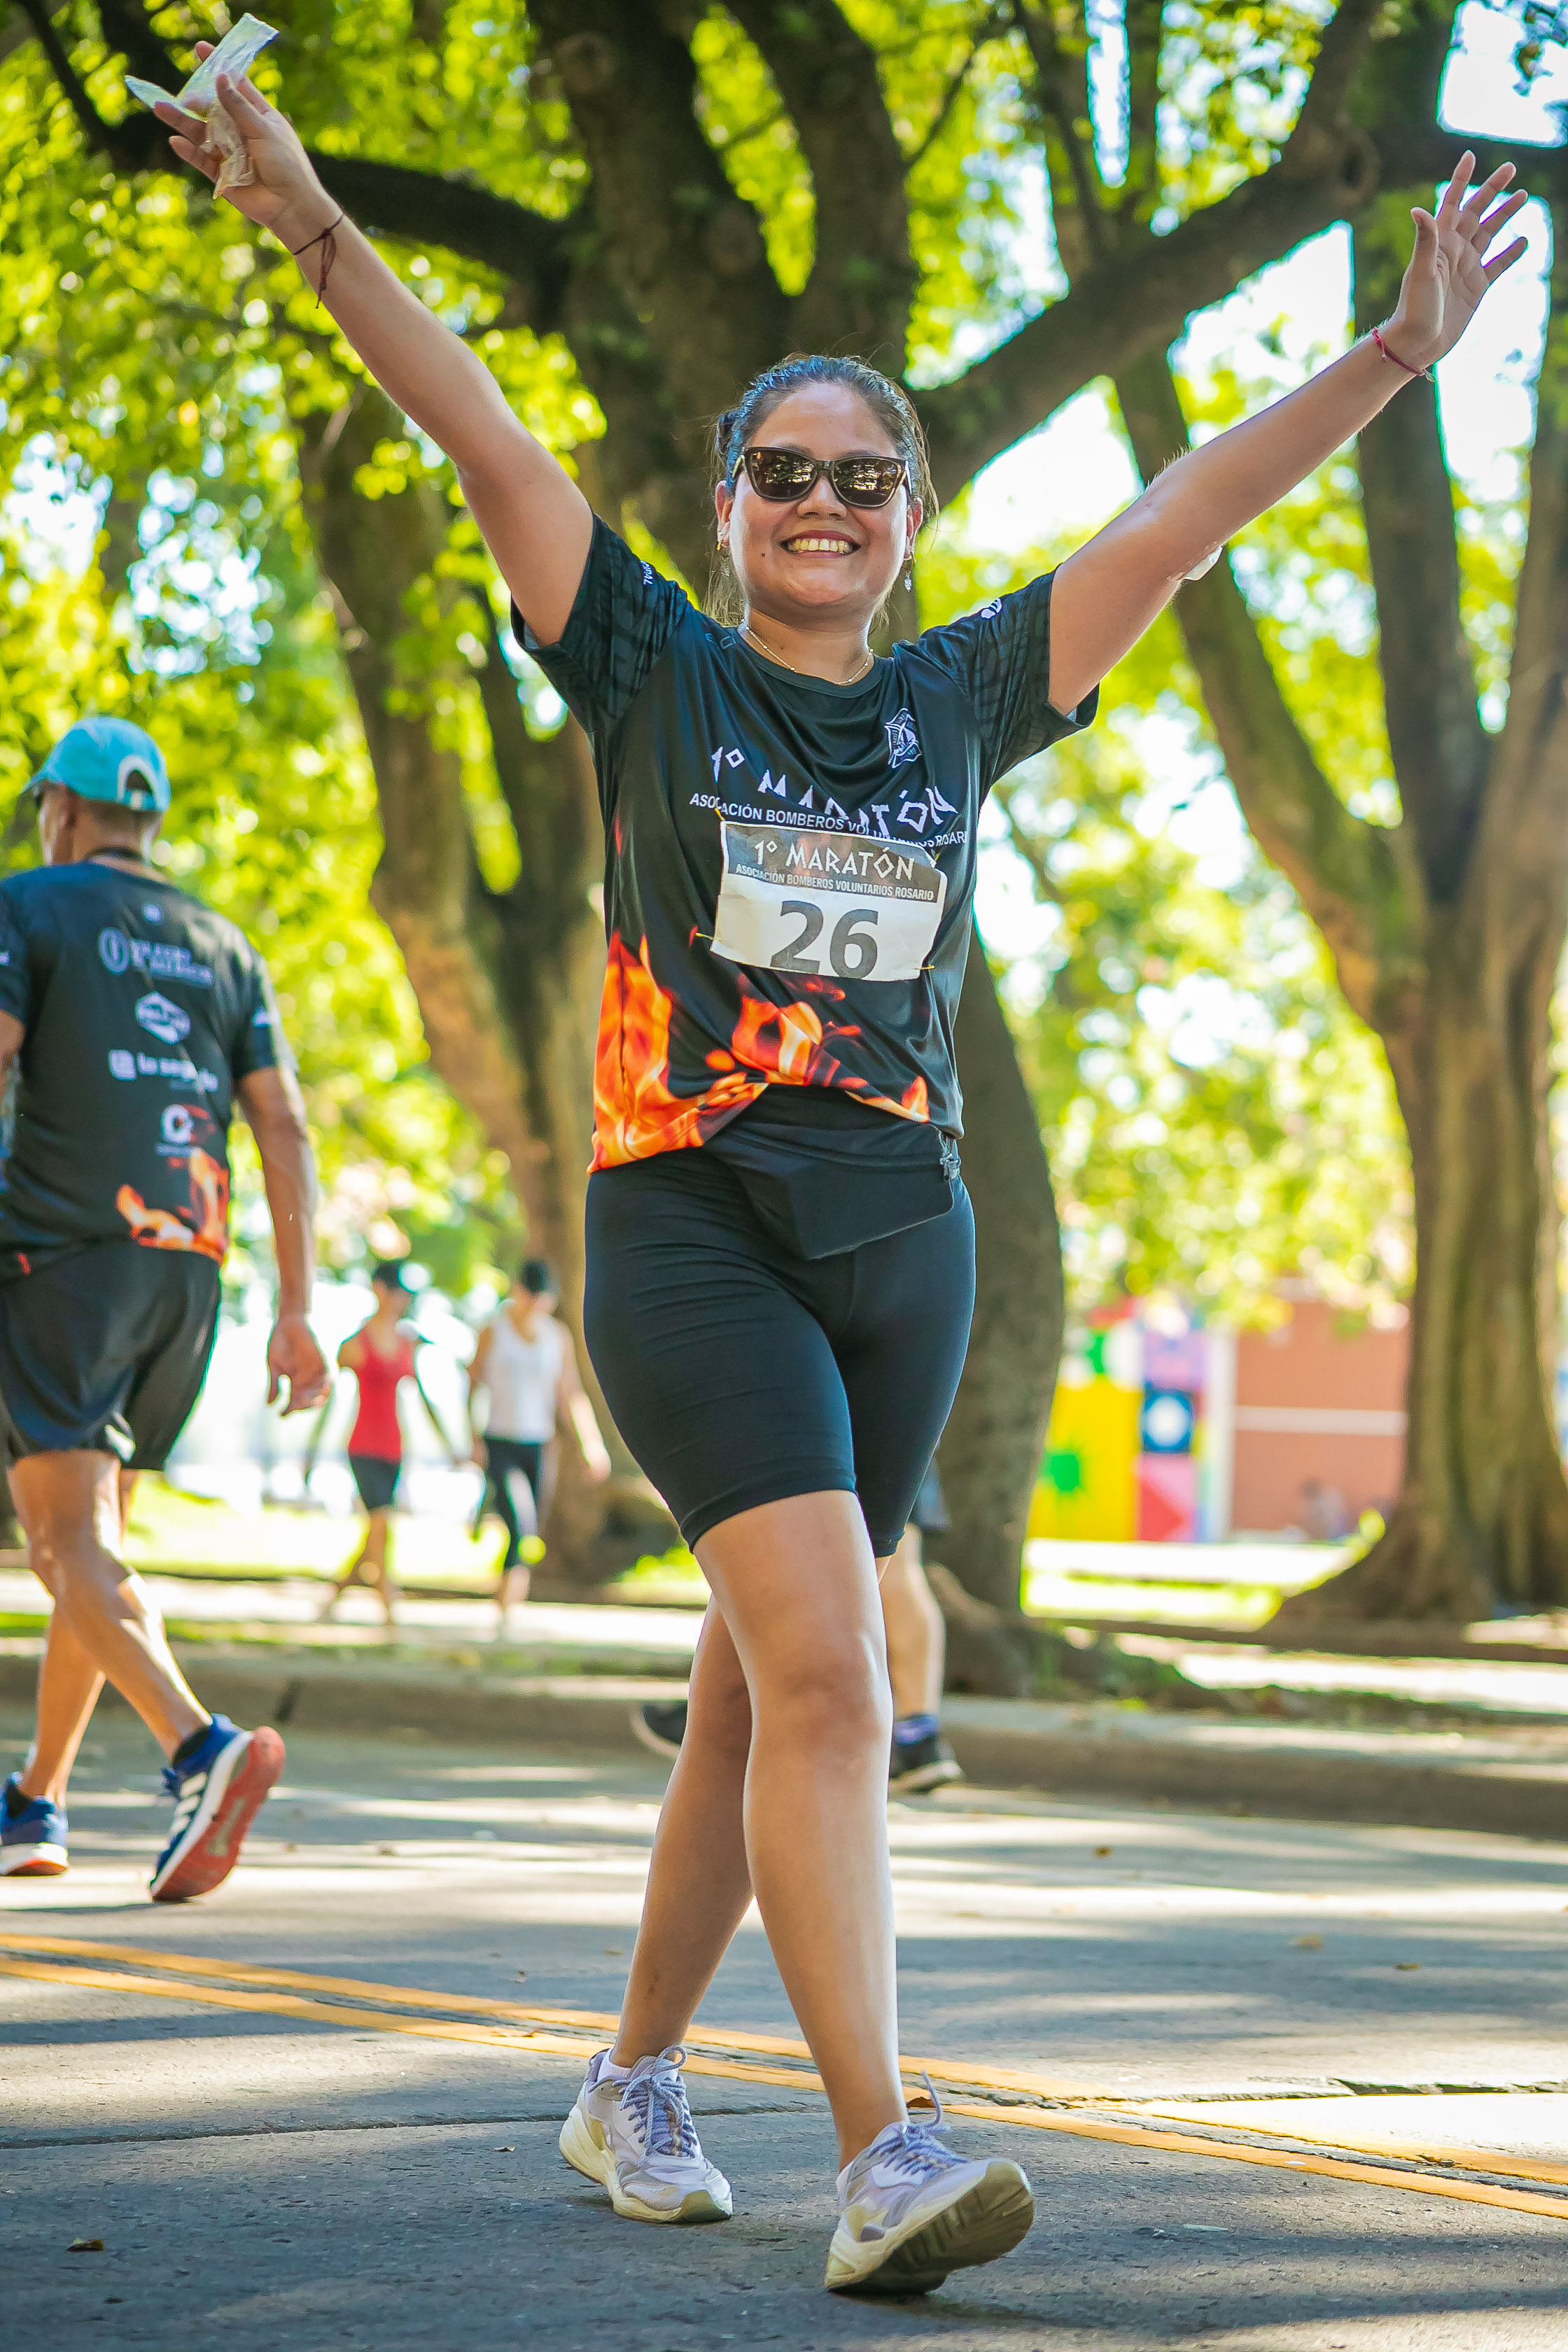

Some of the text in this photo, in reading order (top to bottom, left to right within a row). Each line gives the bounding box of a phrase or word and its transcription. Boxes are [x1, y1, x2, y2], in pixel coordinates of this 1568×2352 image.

[766, 809, 844, 830] BOMBEROS
[785, 843, 914, 881] MARATÓN
[736, 863, 934, 901] ASOCIACIÓN BOMBEROS VOLUNTARIOS ROSARIO
[770, 900, 878, 980] 26
